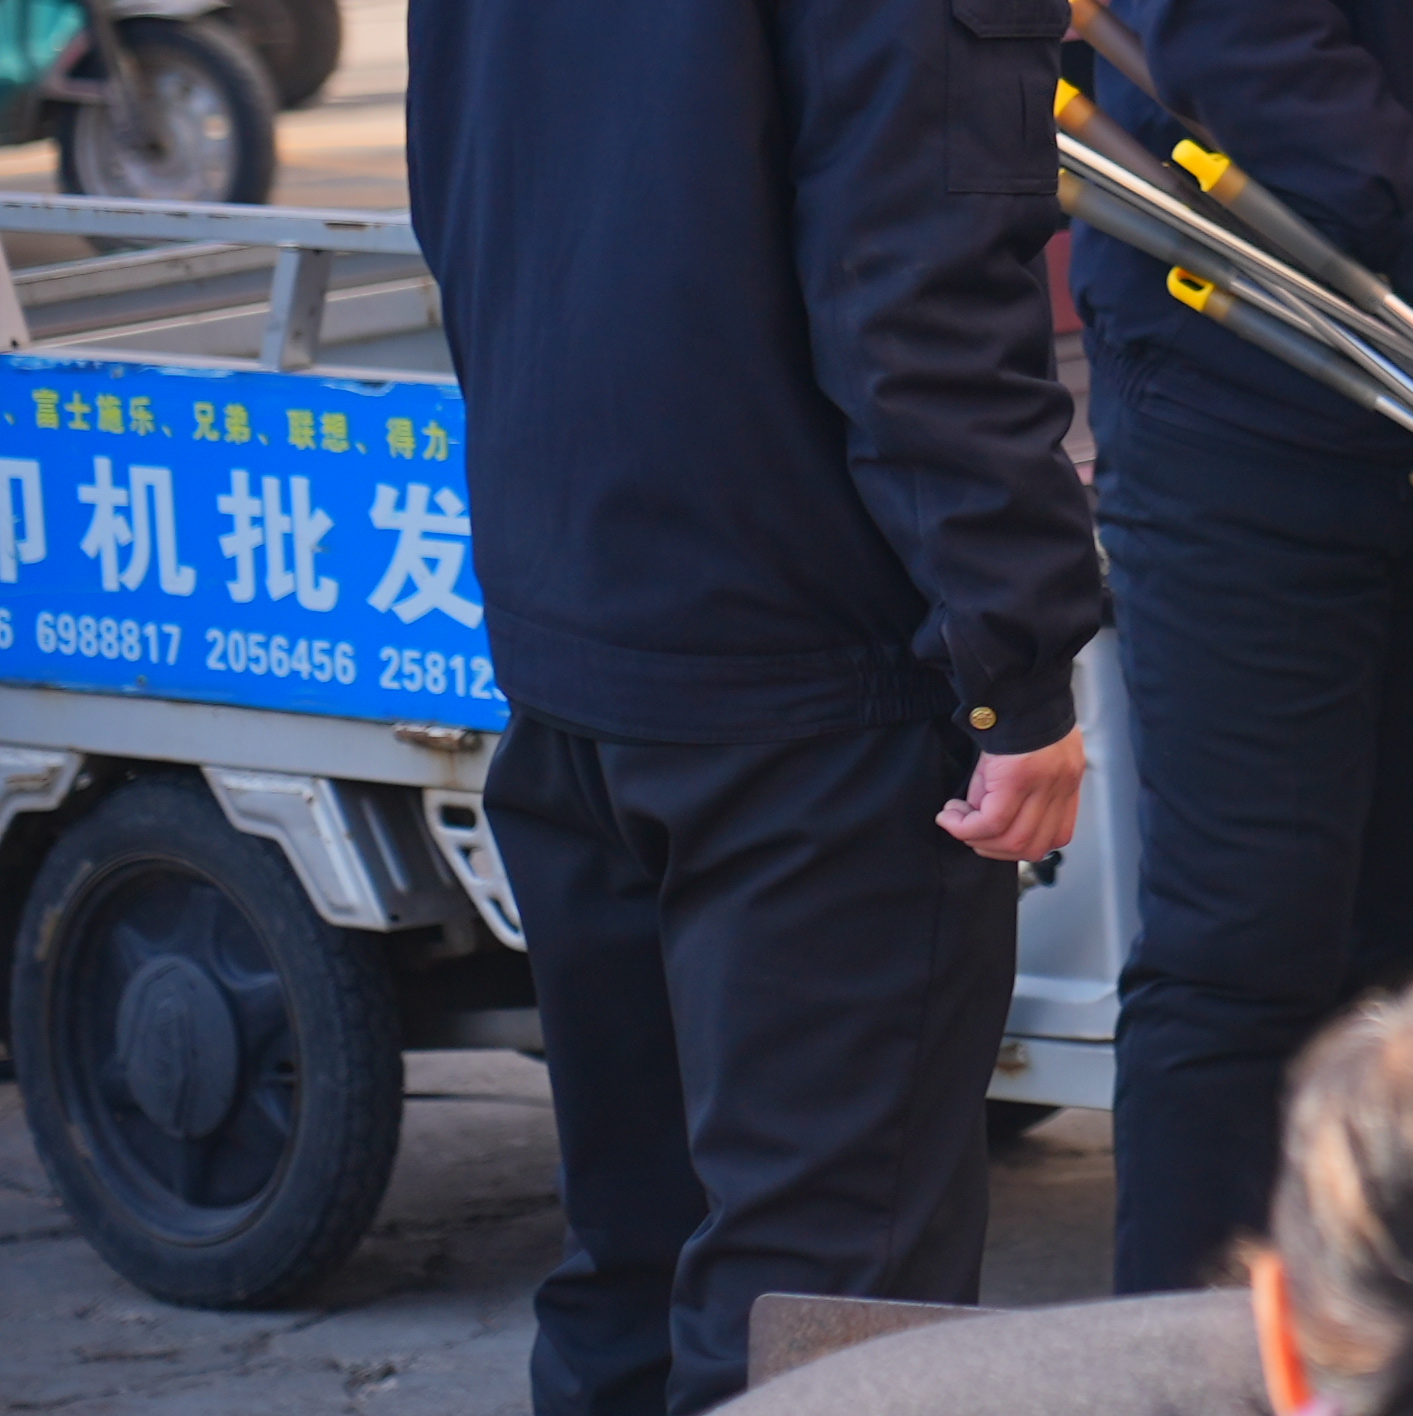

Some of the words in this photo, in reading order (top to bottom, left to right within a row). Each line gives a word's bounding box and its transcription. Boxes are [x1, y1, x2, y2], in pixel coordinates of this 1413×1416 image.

[36, 610, 182, 666] 6988817
[206, 628, 357, 685] 2056456
[379, 646, 508, 702] 25812
